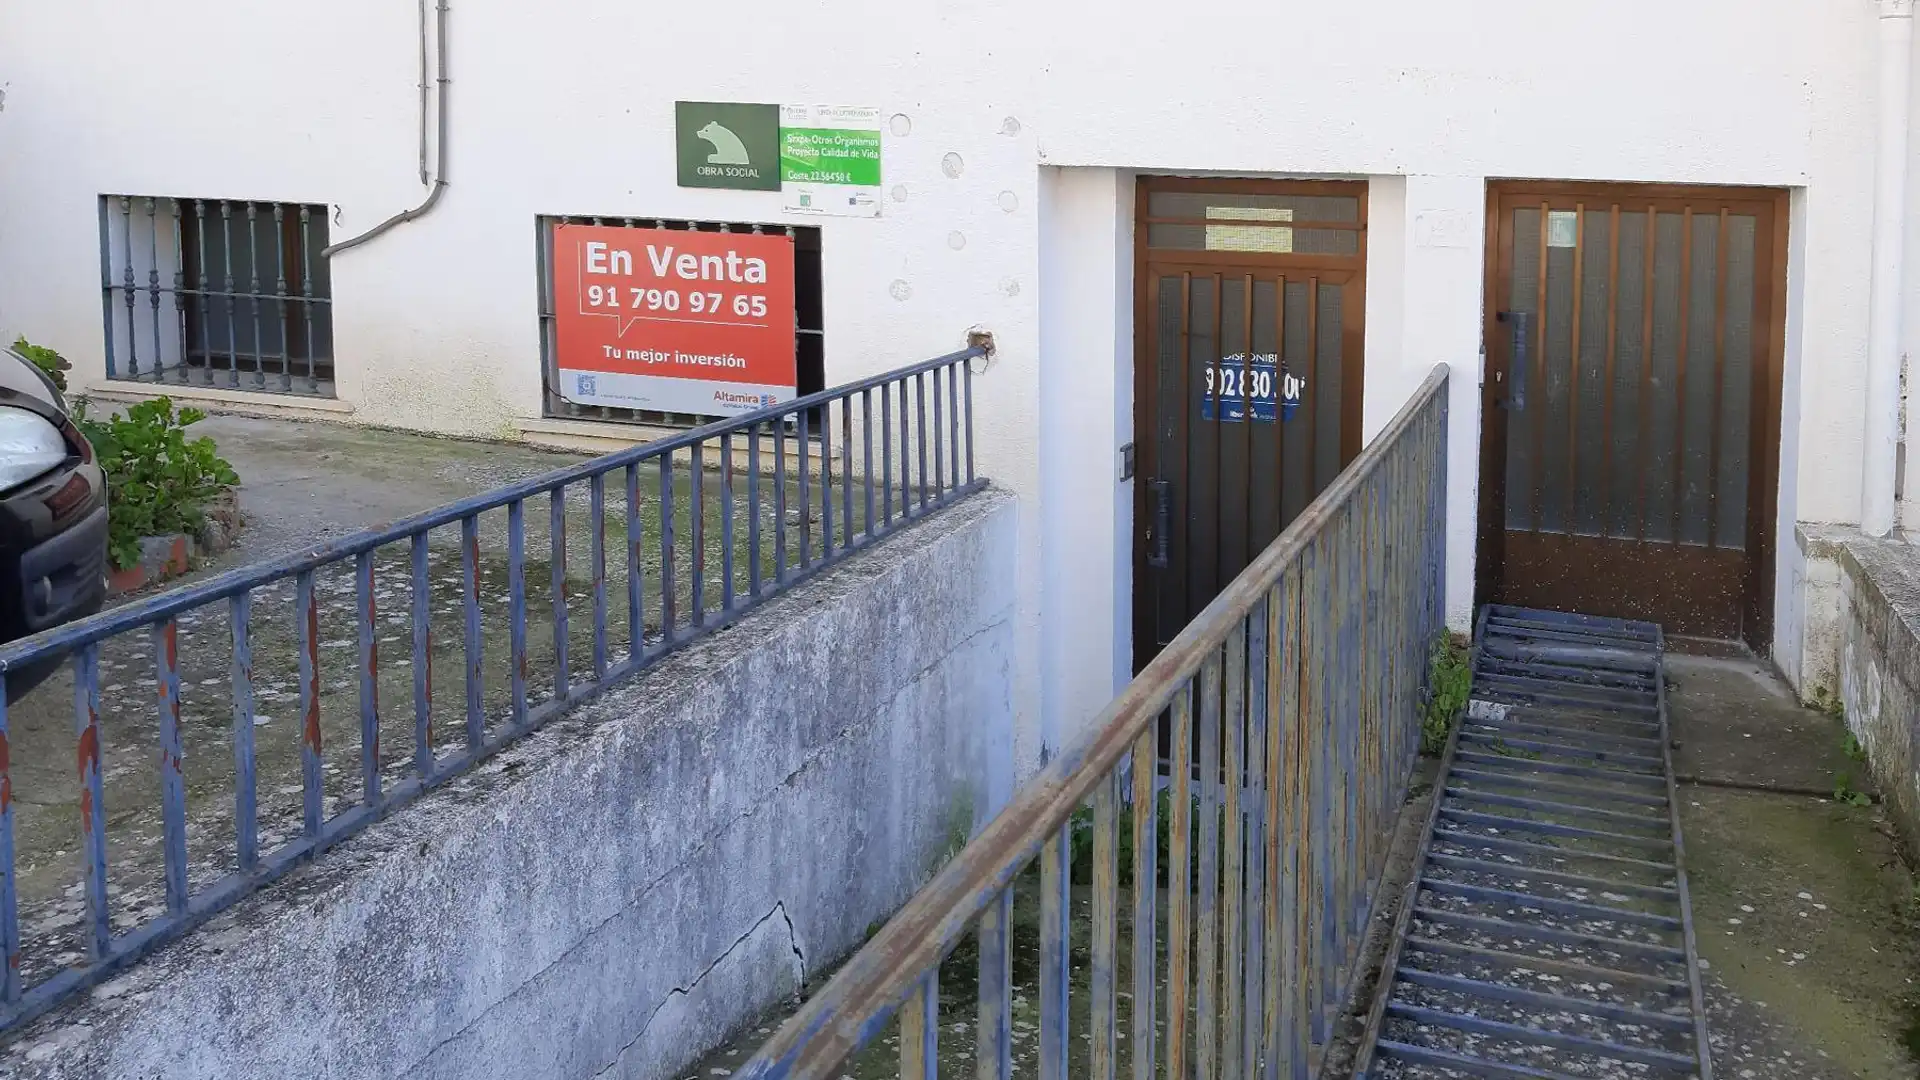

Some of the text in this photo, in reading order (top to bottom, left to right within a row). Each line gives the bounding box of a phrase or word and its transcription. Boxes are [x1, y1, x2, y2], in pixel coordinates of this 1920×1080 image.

[834, 136, 879, 148] Organismos
[787, 146, 879, 159] Proyecto Calidad de Vida
[697, 166, 760, 178] OBRA SOCIAL
[586, 241, 767, 284] En Venta
[588, 285, 768, 317] 91 790 97 65
[602, 344, 747, 369] Tu mejor inversión
[713, 390, 760, 405] Altamira
